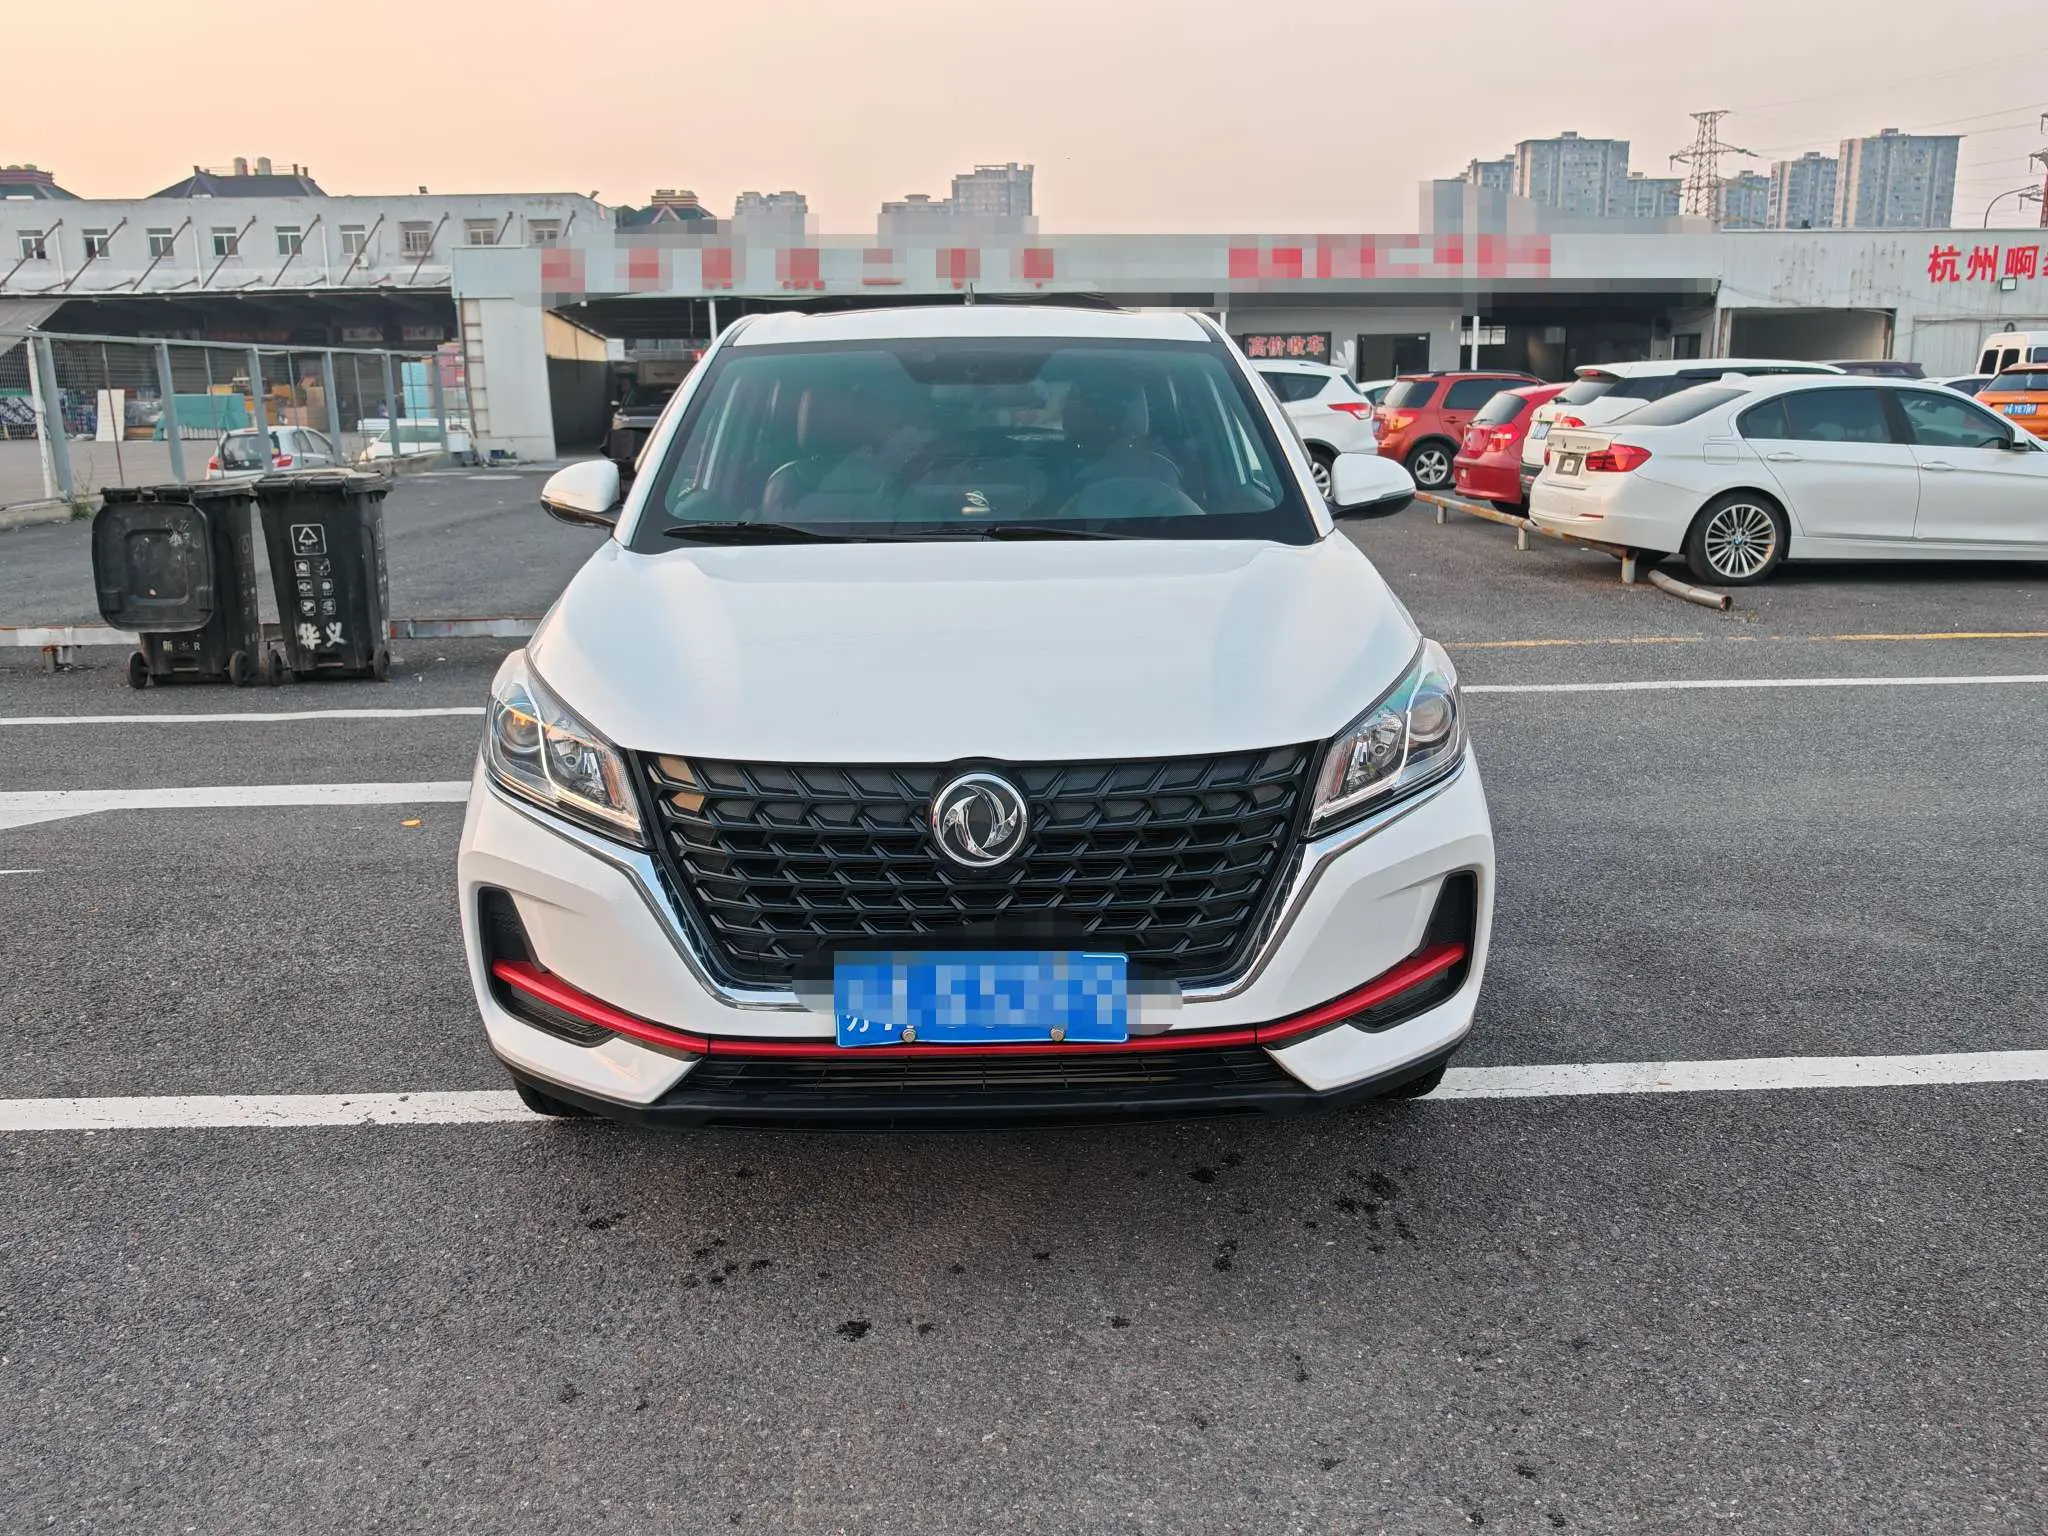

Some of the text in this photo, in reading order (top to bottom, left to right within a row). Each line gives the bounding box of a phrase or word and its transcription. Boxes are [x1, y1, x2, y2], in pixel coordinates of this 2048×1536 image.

[1927, 243, 2048, 283] 杭州啊
[1248, 335, 1325, 357] 高价收车
